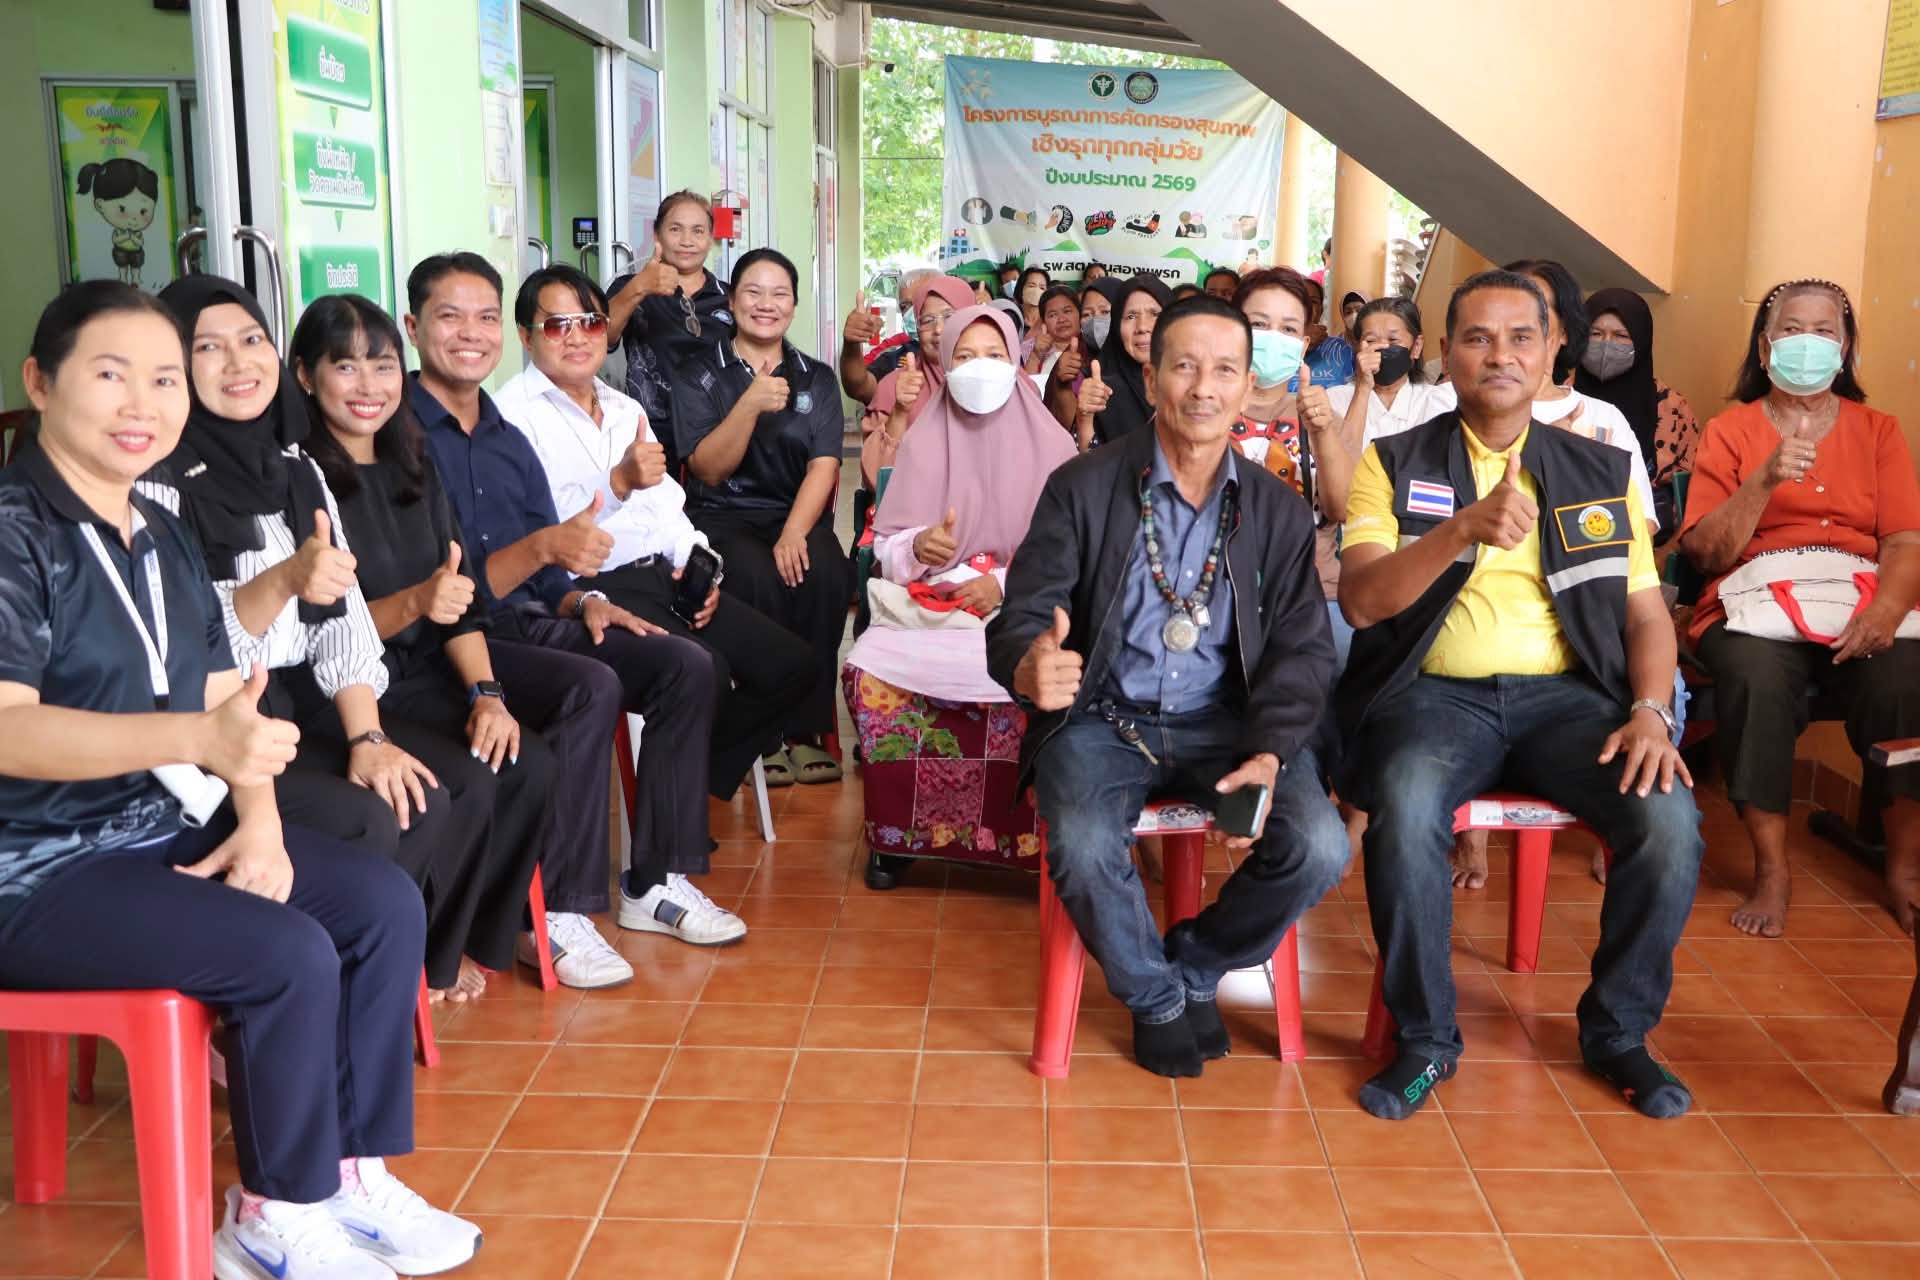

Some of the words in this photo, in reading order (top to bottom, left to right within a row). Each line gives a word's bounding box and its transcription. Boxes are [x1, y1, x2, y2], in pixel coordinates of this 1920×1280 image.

[963, 104, 1257, 138] โครงการบูรณาการคัดกรองสุขภาพ
[1031, 133, 1203, 164] เชิงรุกทุกกลุ่มวัย
[1045, 168, 1147, 188] ปีงบประมาณ
[1152, 174, 1197, 192] 2569
